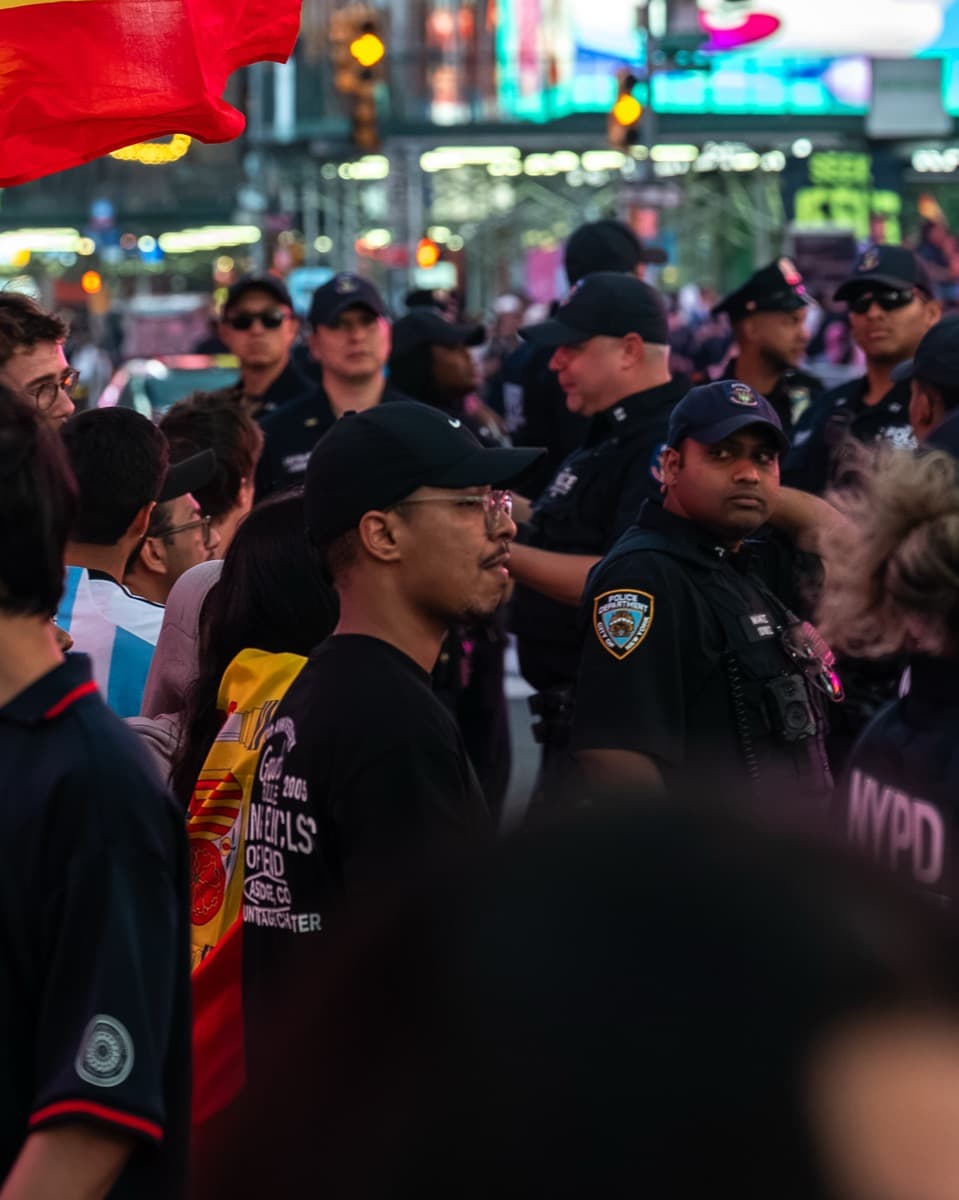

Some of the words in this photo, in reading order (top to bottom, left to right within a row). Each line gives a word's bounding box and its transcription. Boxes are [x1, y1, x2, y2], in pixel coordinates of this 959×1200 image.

[608, 593, 638, 602] POLICE
[598, 600, 649, 614] DEPARTMENT
[848, 768, 944, 884] NYPD
